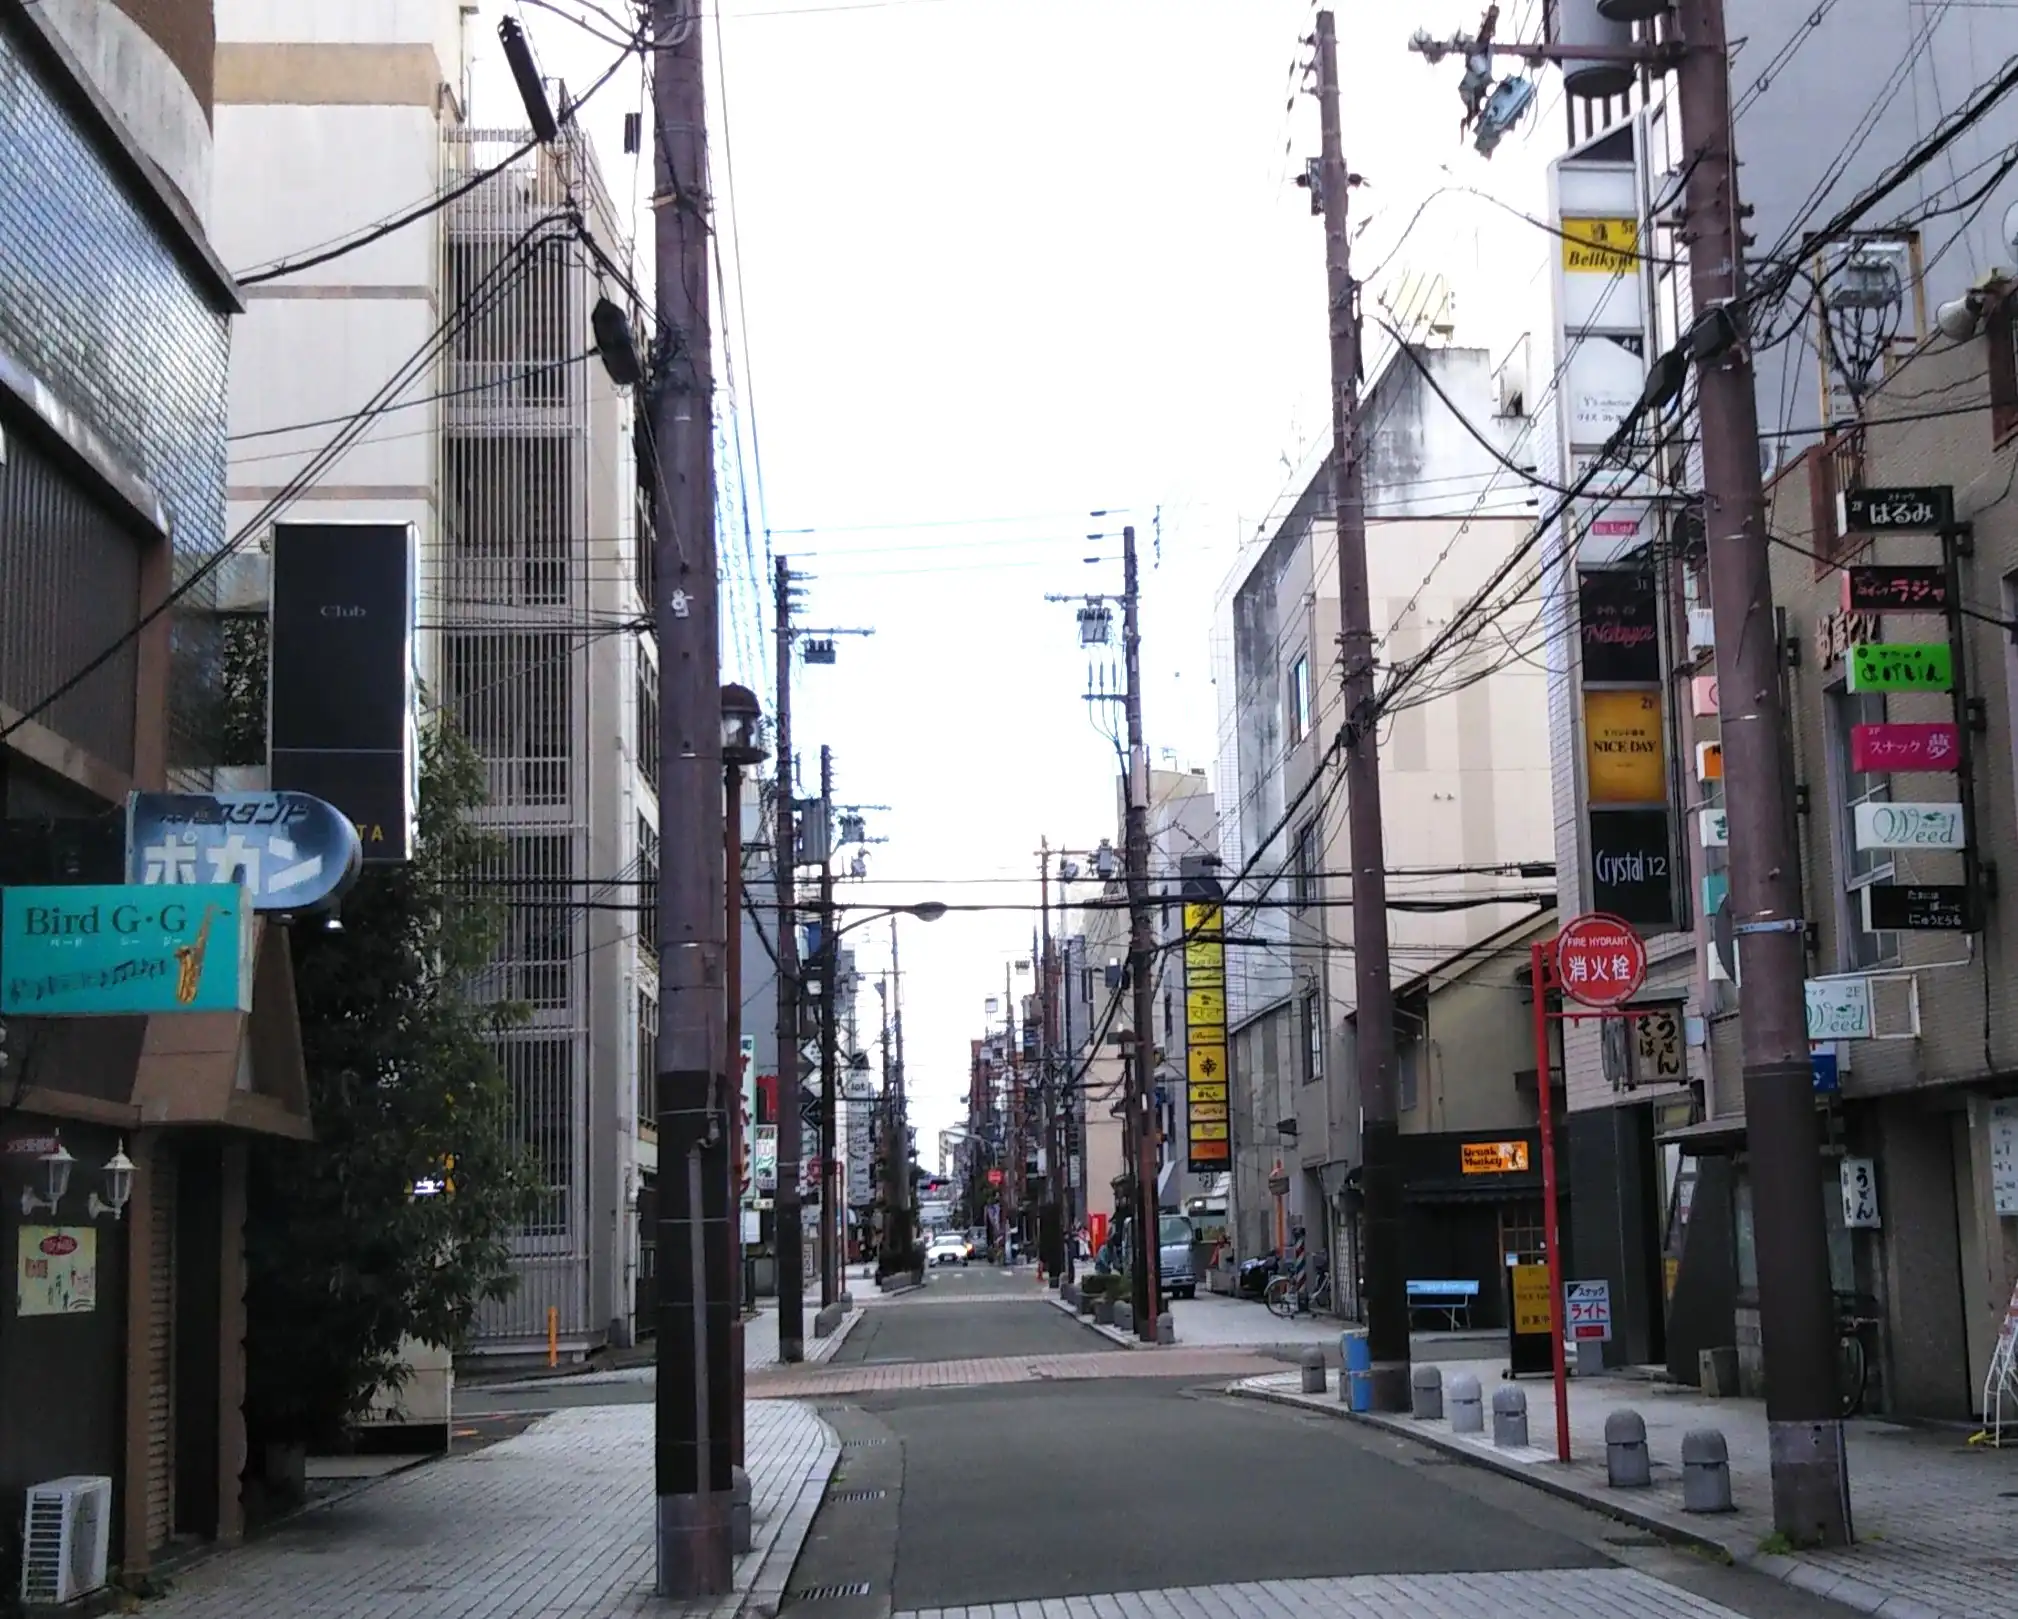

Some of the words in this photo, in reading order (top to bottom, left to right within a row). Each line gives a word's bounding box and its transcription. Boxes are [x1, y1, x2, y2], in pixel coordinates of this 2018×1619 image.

[1869, 502, 1934, 525] はるみ
[320, 605, 366, 618] Club
[1594, 740, 1628, 753] NICE
[1629, 740, 1656, 753] DAY
[1870, 740, 1921, 755] スナック
[1926, 733, 1952, 760] 夢
[1873, 807, 1956, 844] Weed
[144, 830, 322, 895] ポカン
[1596, 850, 1644, 887] Crystal
[1647, 857, 1667, 875] 12
[25, 907, 100, 935] Bird
[1567, 937, 1586, 947] FIRE
[1589, 936, 1628, 948] HYDRANT
[1568, 954, 1631, 982] 消火栓
[1845, 986, 1861, 998] 2F
[1656, 1012, 1680, 1076] うどん
[1856, 1166, 1874, 1220] うどん
[1578, 1287, 1605, 1297] スナック
[1571, 1302, 1607, 1320] ライト
